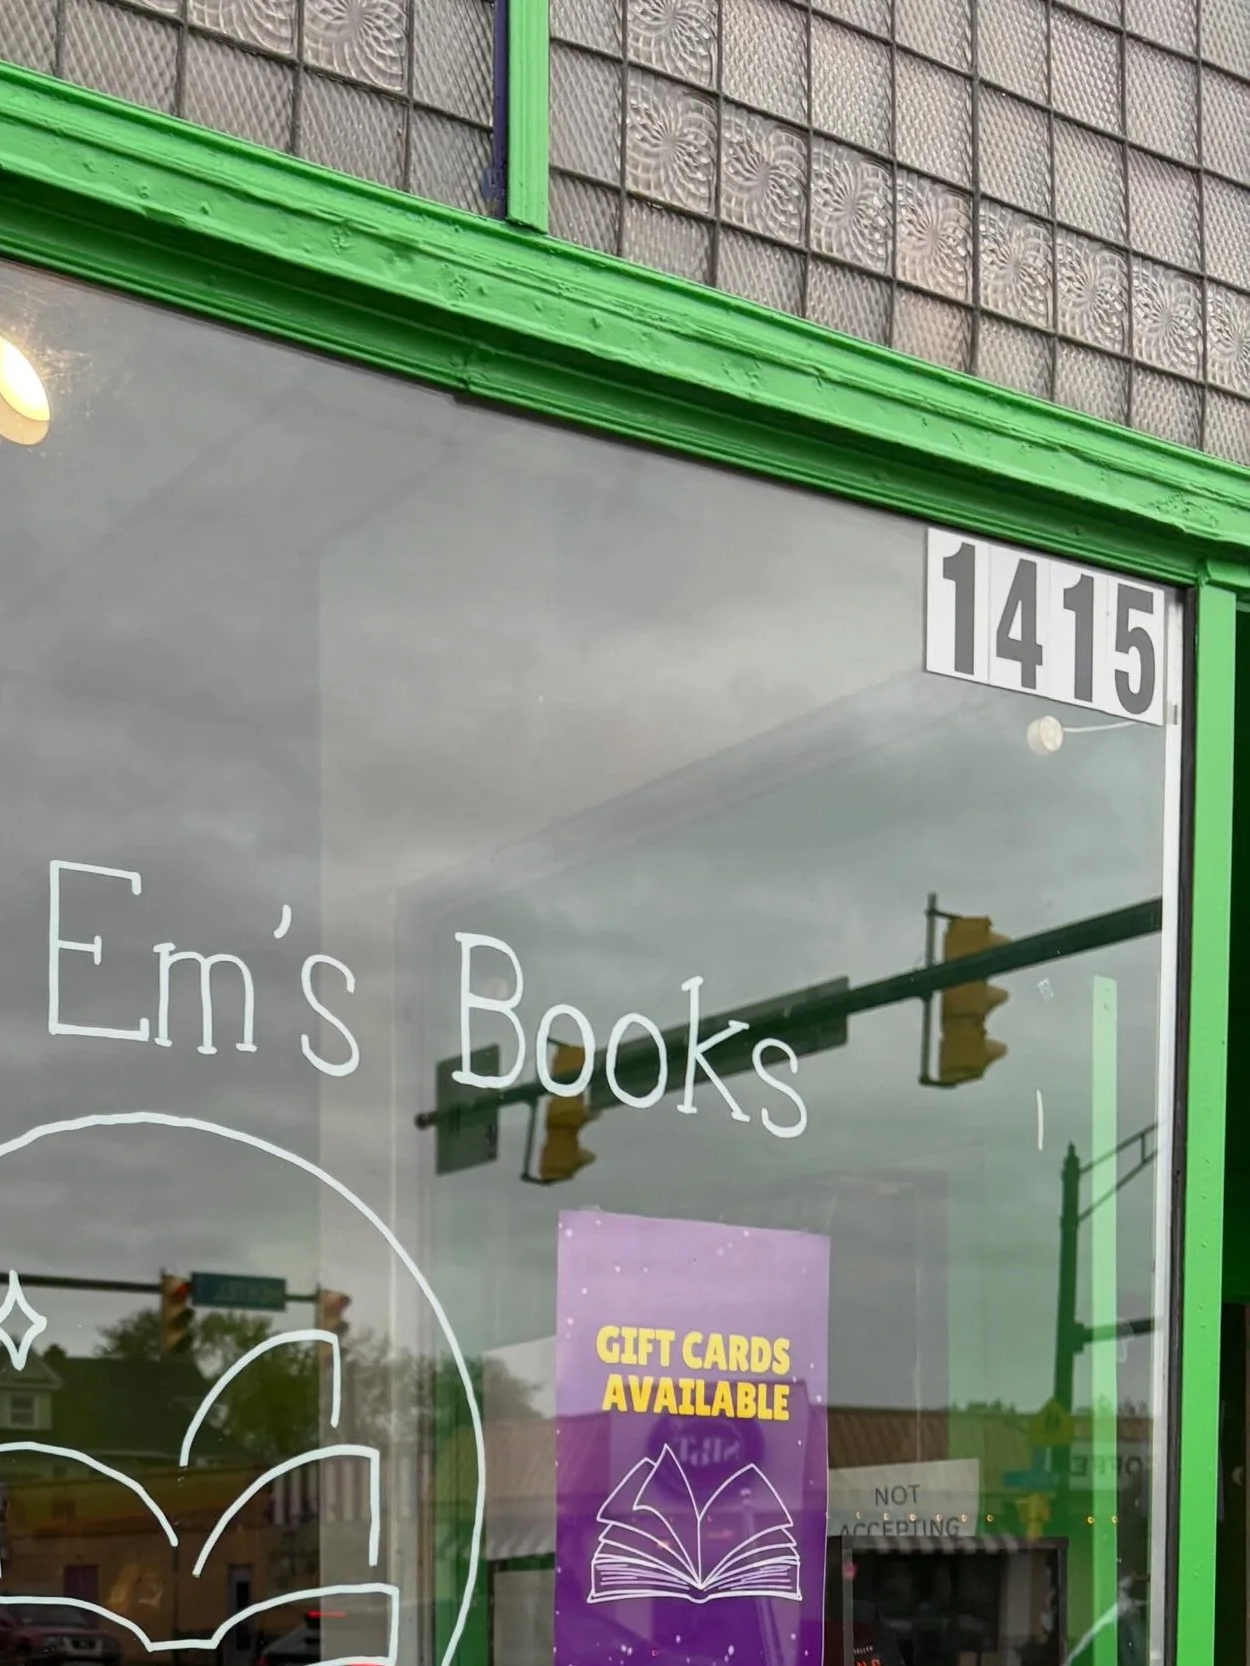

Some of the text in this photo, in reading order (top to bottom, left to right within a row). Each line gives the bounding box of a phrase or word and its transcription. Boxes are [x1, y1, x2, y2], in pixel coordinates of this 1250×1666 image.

[942, 541, 1156, 715] 1415
[48, 859, 360, 1077] Em's
[452, 931, 808, 1138] Books
[596, 1324, 790, 1375] GIFT CARDS
[602, 1373, 790, 1421] AVAILABLE
[874, 1484, 920, 1506] NOT
